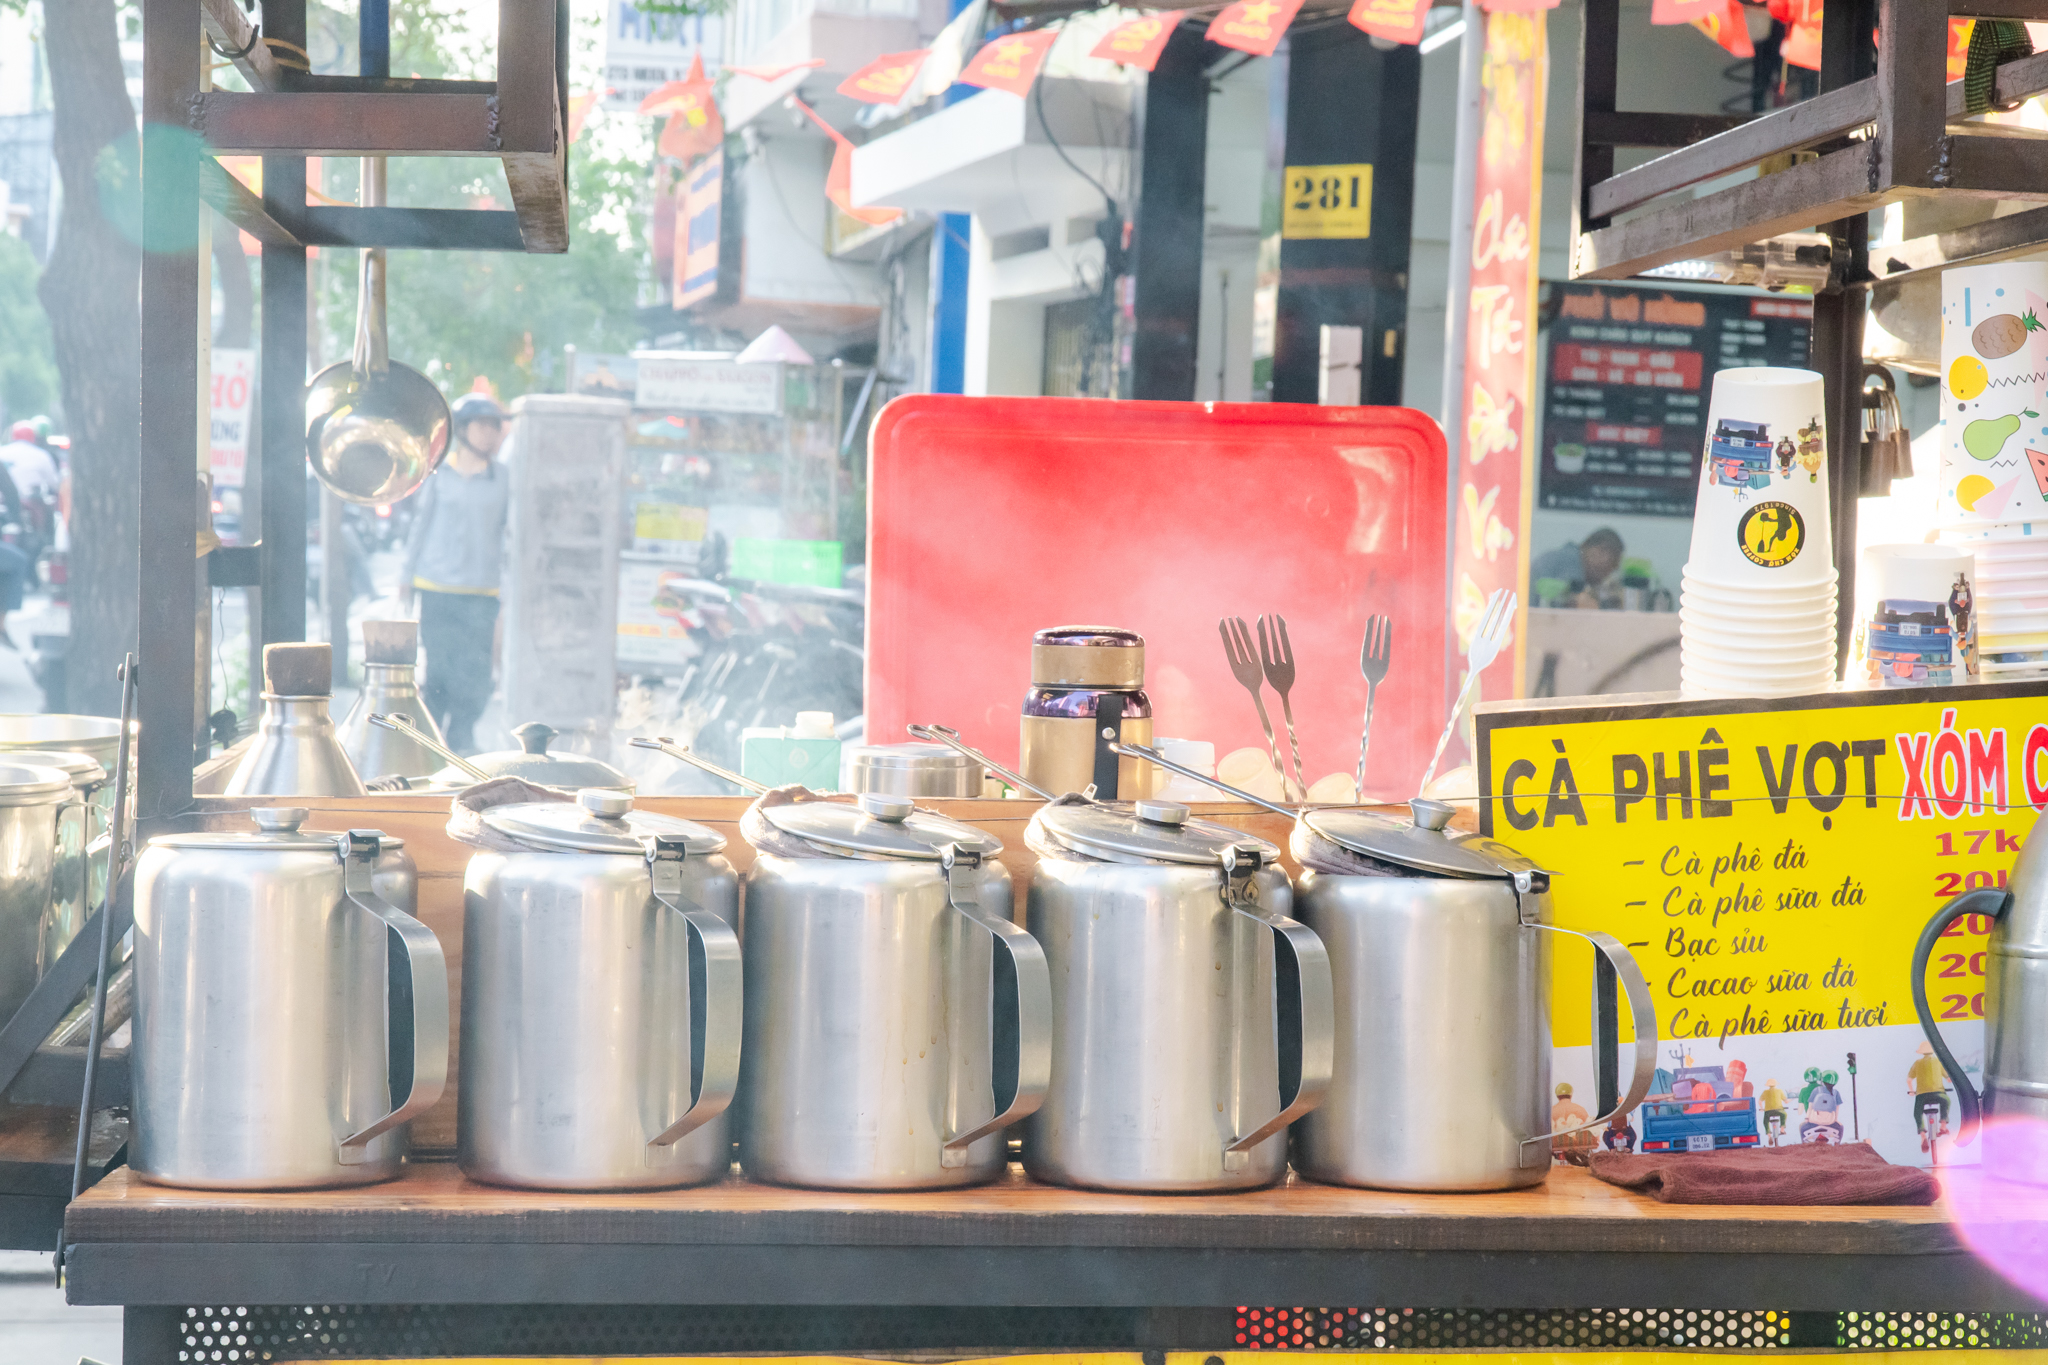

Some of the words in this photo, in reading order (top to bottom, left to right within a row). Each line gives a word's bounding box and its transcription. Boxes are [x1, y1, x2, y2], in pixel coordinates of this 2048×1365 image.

[1292, 175, 1360, 210] 281
[1754, 502, 1774, 513] 1972
[1775, 502, 1797, 515] Since
[1741, 544, 1764, 565] COFFEE
[1502, 738, 1588, 831] CÀ
[1612, 728, 1732, 823] PHÊ
[1755, 738, 1886, 831] VỢT
[1895, 708, 2009, 821] XÓM
[1935, 829, 2021, 856] 17k
[1660, 845, 1704, 876] Cà
[1710, 841, 1764, 888] phê
[1774, 838, 1809, 870] đá
[1662, 886, 1706, 917] Cà
[1712, 882, 1765, 928] phê
[1774, 887, 1821, 912] sữa
[1831, 875, 1867, 907] đá
[1665, 926, 1721, 962] Bạc
[1729, 927, 1768, 955] sỉu
[1667, 967, 1758, 998] Cacao
[1765, 969, 1812, 993] sữa
[1822, 957, 1857, 989] đá
[1669, 1008, 1713, 1040] Cà
[1718, 1003, 1772, 1050] phê
[1781, 1009, 1828, 1033] sữa
[1837, 997, 1888, 1029] tươi
